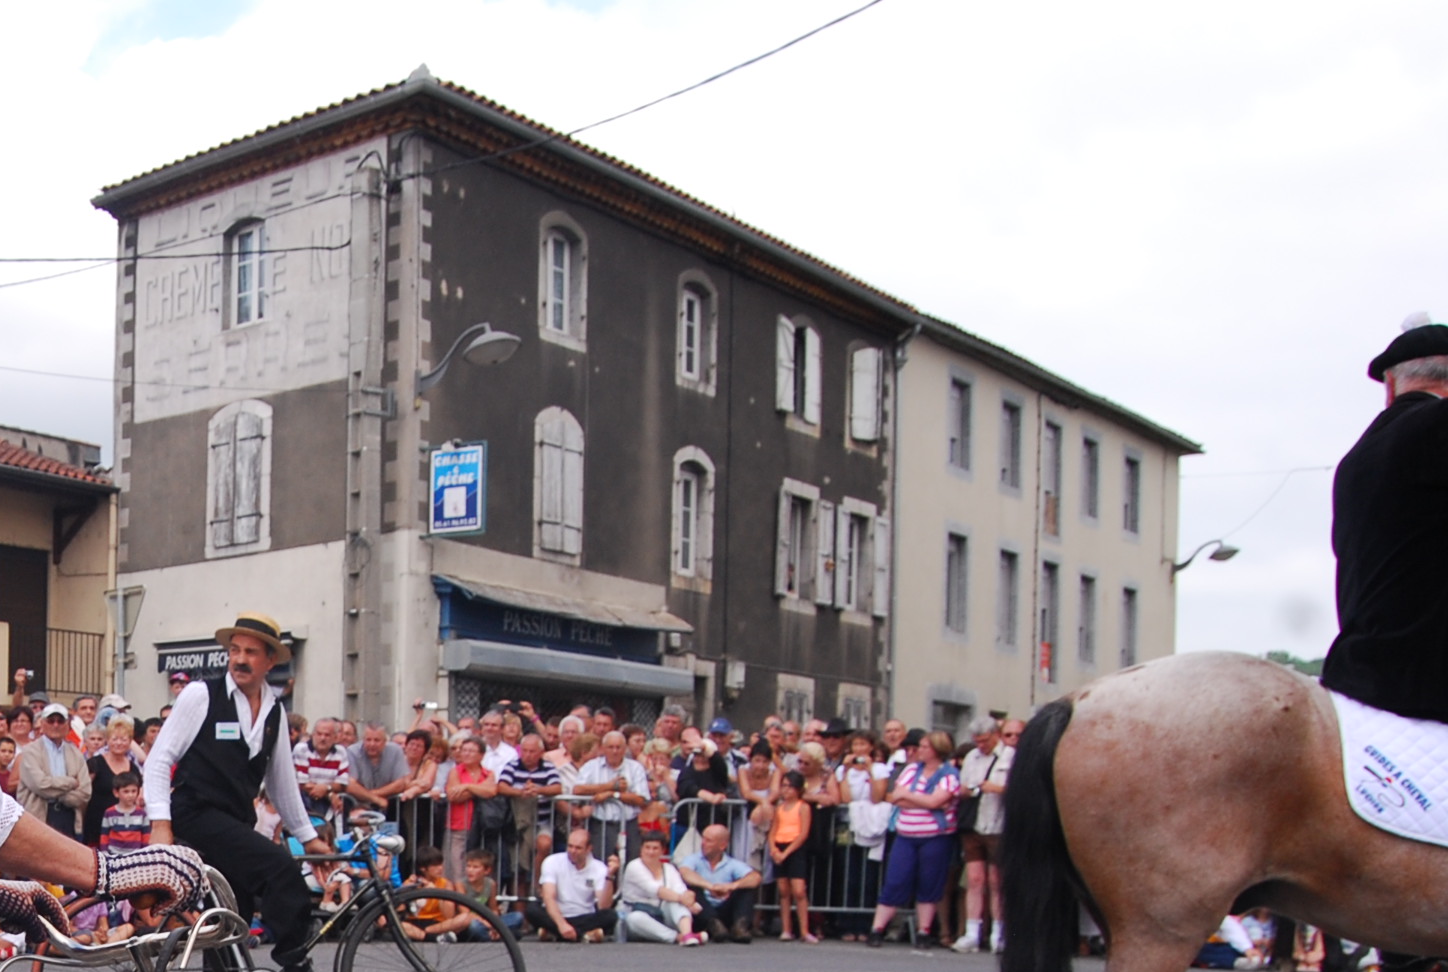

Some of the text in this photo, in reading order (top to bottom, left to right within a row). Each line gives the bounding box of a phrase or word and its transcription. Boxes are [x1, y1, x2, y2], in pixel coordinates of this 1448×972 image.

[435, 452, 479, 468] CHASSE
[503, 610, 562, 639] PASSION
[165, 653, 204, 669] PASSION
[1364, 745, 1396, 773] GUIDES
[1400, 778, 1433, 812] CHEVAL
